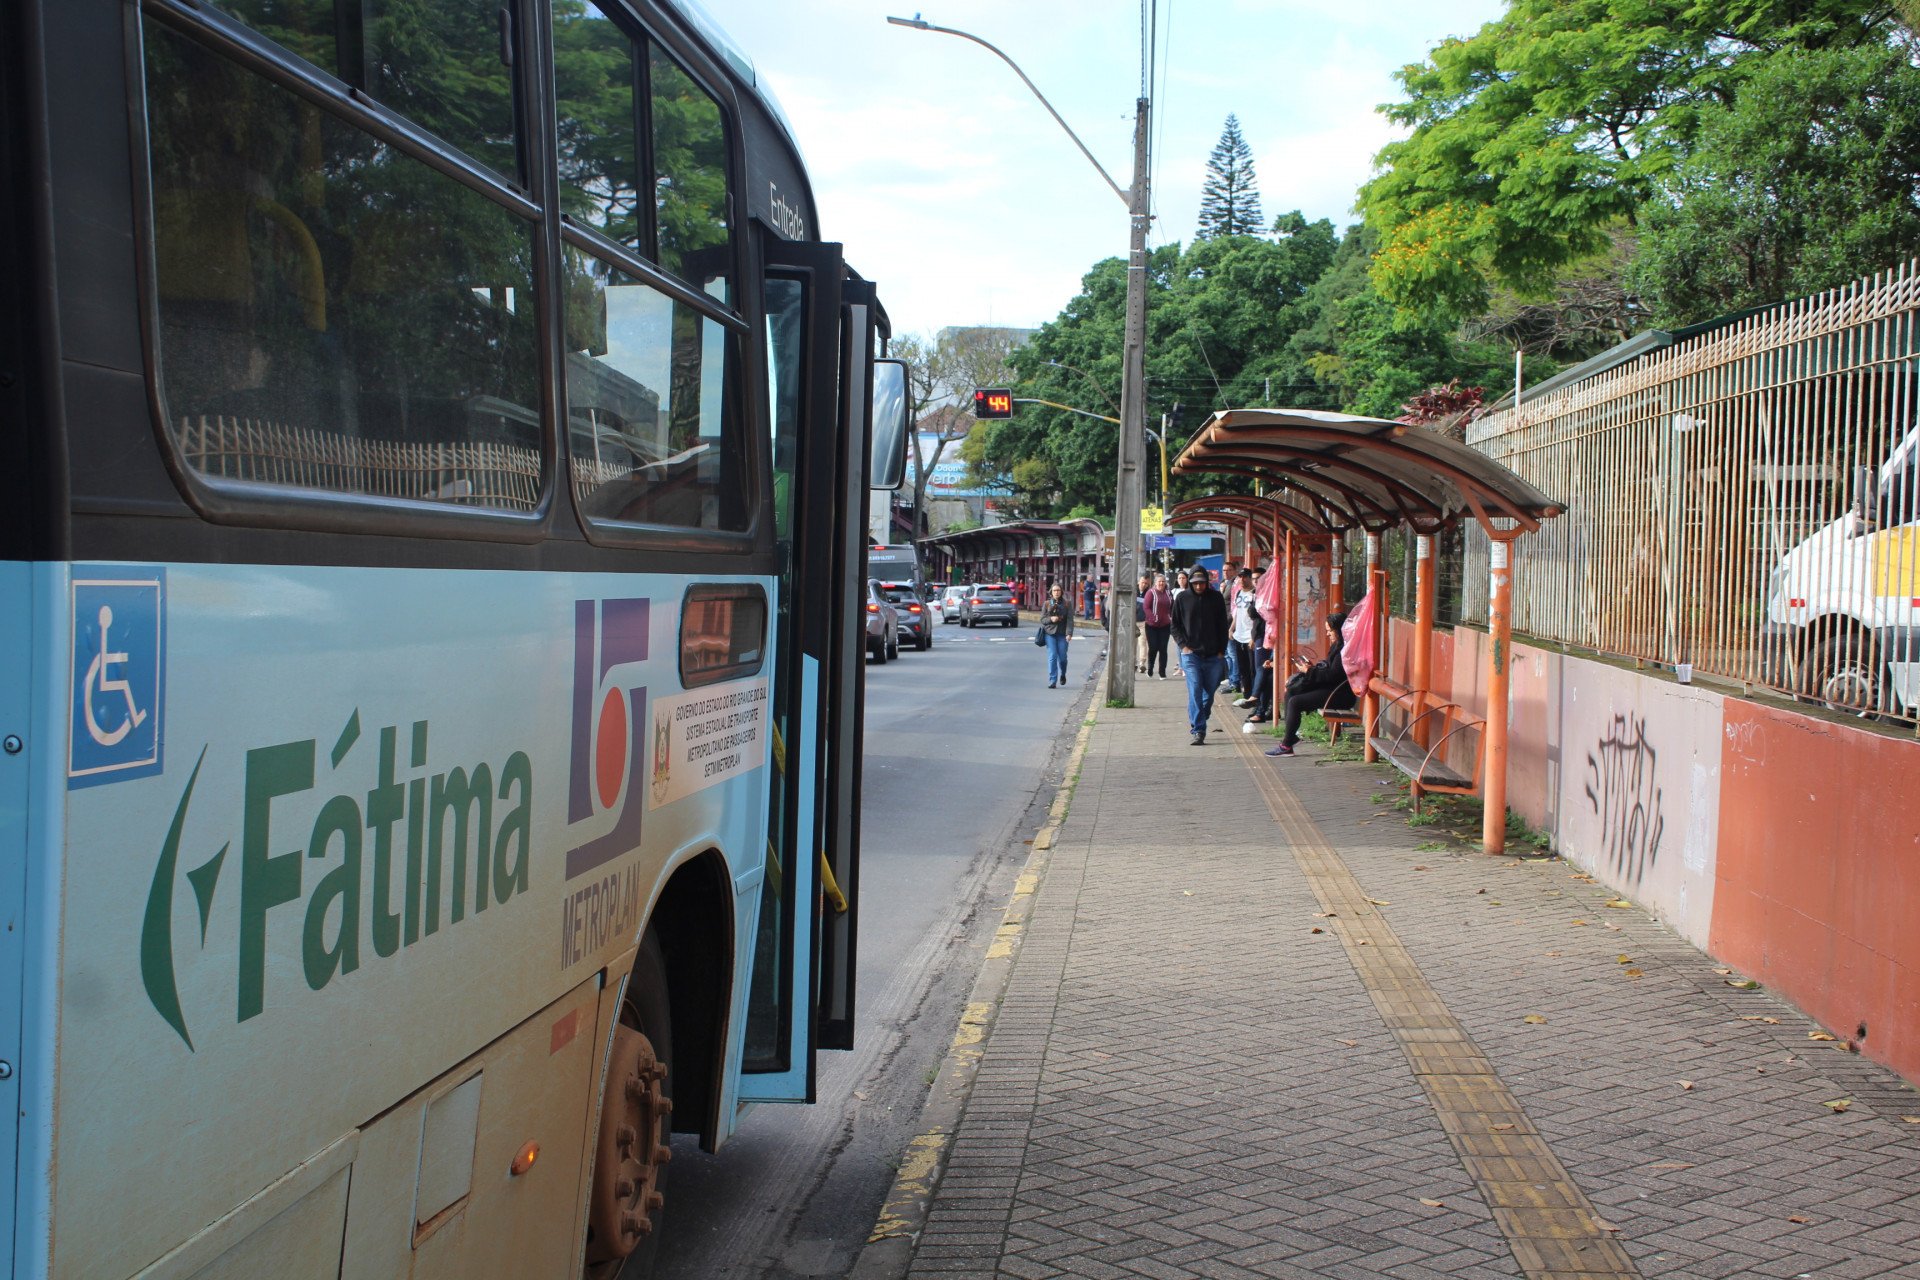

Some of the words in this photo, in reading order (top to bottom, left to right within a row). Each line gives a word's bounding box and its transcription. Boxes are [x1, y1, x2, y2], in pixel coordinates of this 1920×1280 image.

[769, 181, 804, 241] Entrada
[988, 396, 1009, 411] 44
[676, 702, 698, 721] GOVERNO
[699, 701, 706, 716] DO
[706, 698, 723, 712] ESTADO
[723, 695, 729, 710] DO
[738, 690, 754, 705] GRANDE
[754, 688, 760, 701] DO
[686, 722, 705, 741] SISTEMA
[706, 717, 727, 735] ESTADUAL
[728, 713, 733, 728] DE
[734, 708, 759, 727] TRANSPORTE
[687, 738, 723, 762] METROPOLITANO
[724, 735, 729, 750] DE
[730, 728, 756, 748] PASSAGEIROS
[238, 707, 532, 1024] Fátima
[561, 861, 641, 971] METROPLAN
